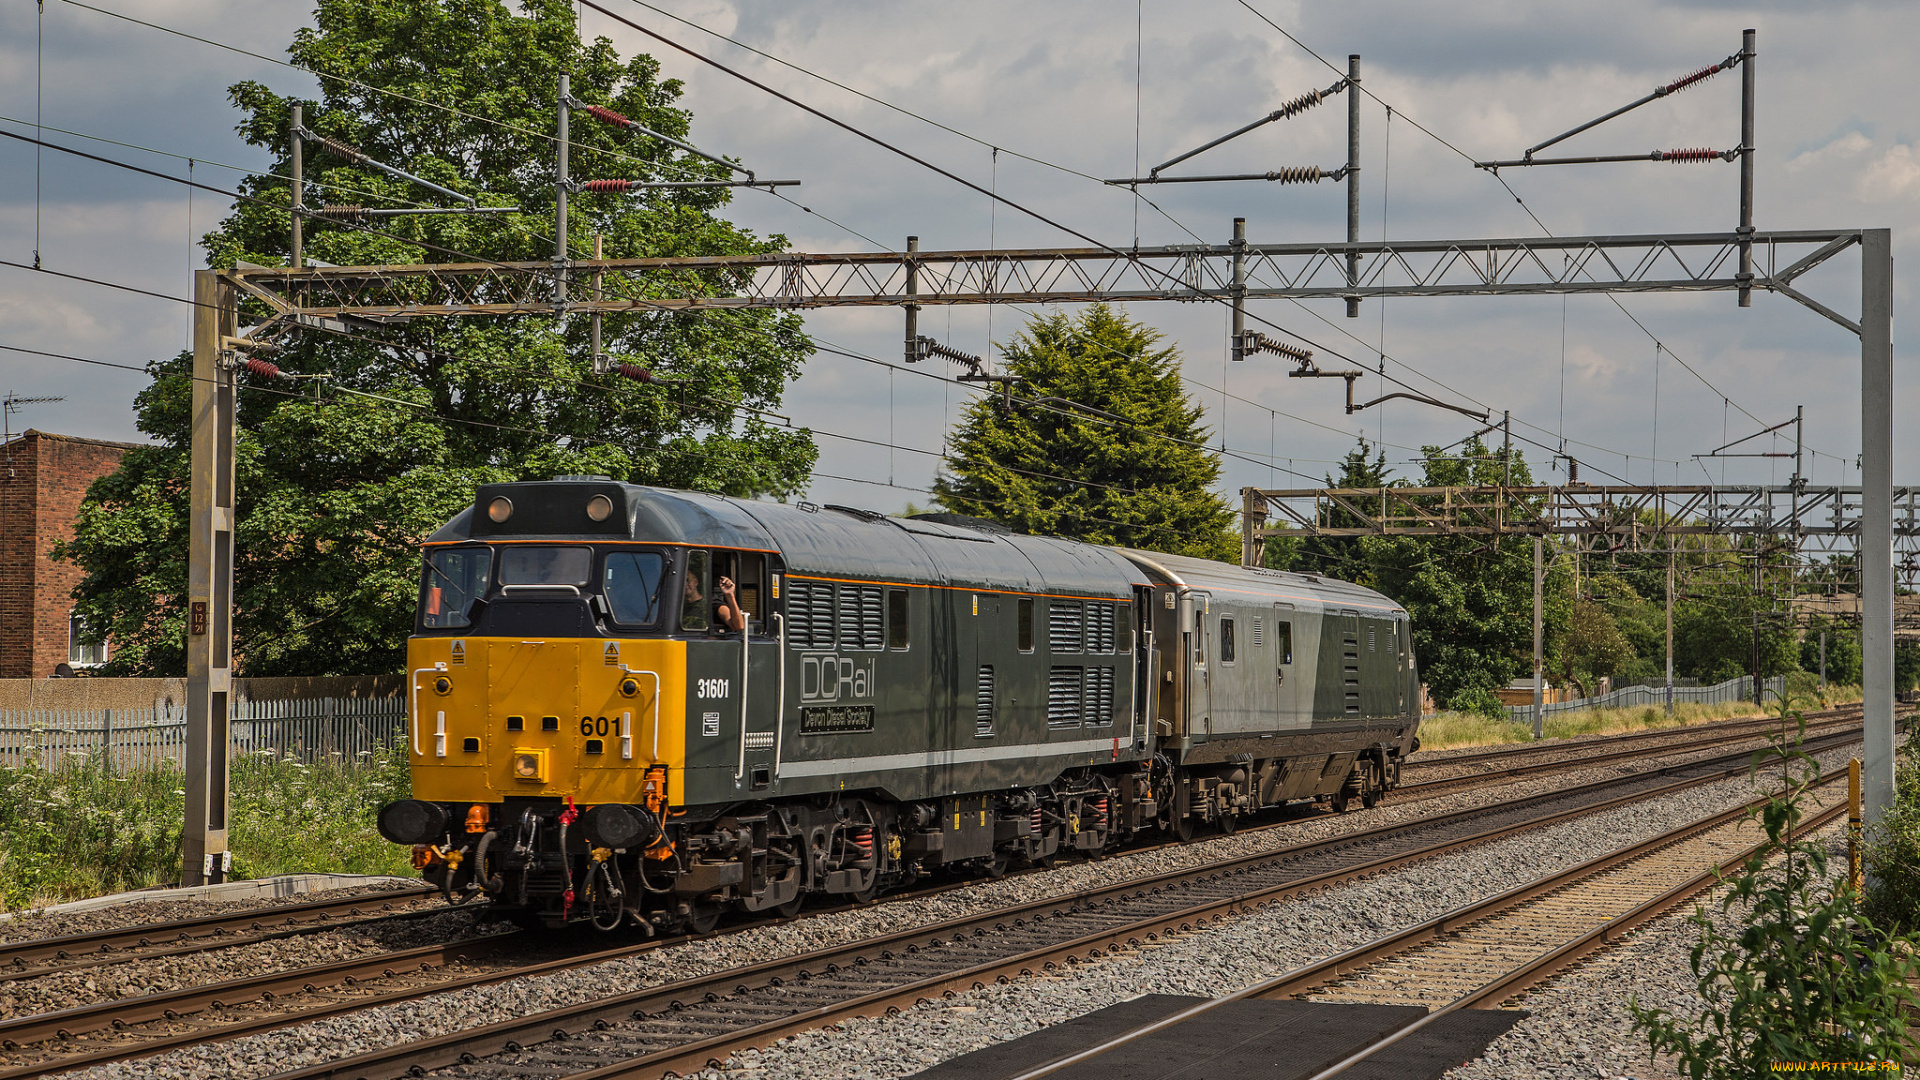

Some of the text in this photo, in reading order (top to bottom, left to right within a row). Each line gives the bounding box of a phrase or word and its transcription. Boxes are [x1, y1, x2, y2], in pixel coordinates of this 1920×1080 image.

[194, 624, 204, 633] 21
[195, 613, 204, 623] 12
[697, 678, 729, 699] 31601
[580, 715, 620, 737] 601
[804, 707, 871, 728] Devon Diesel Society
